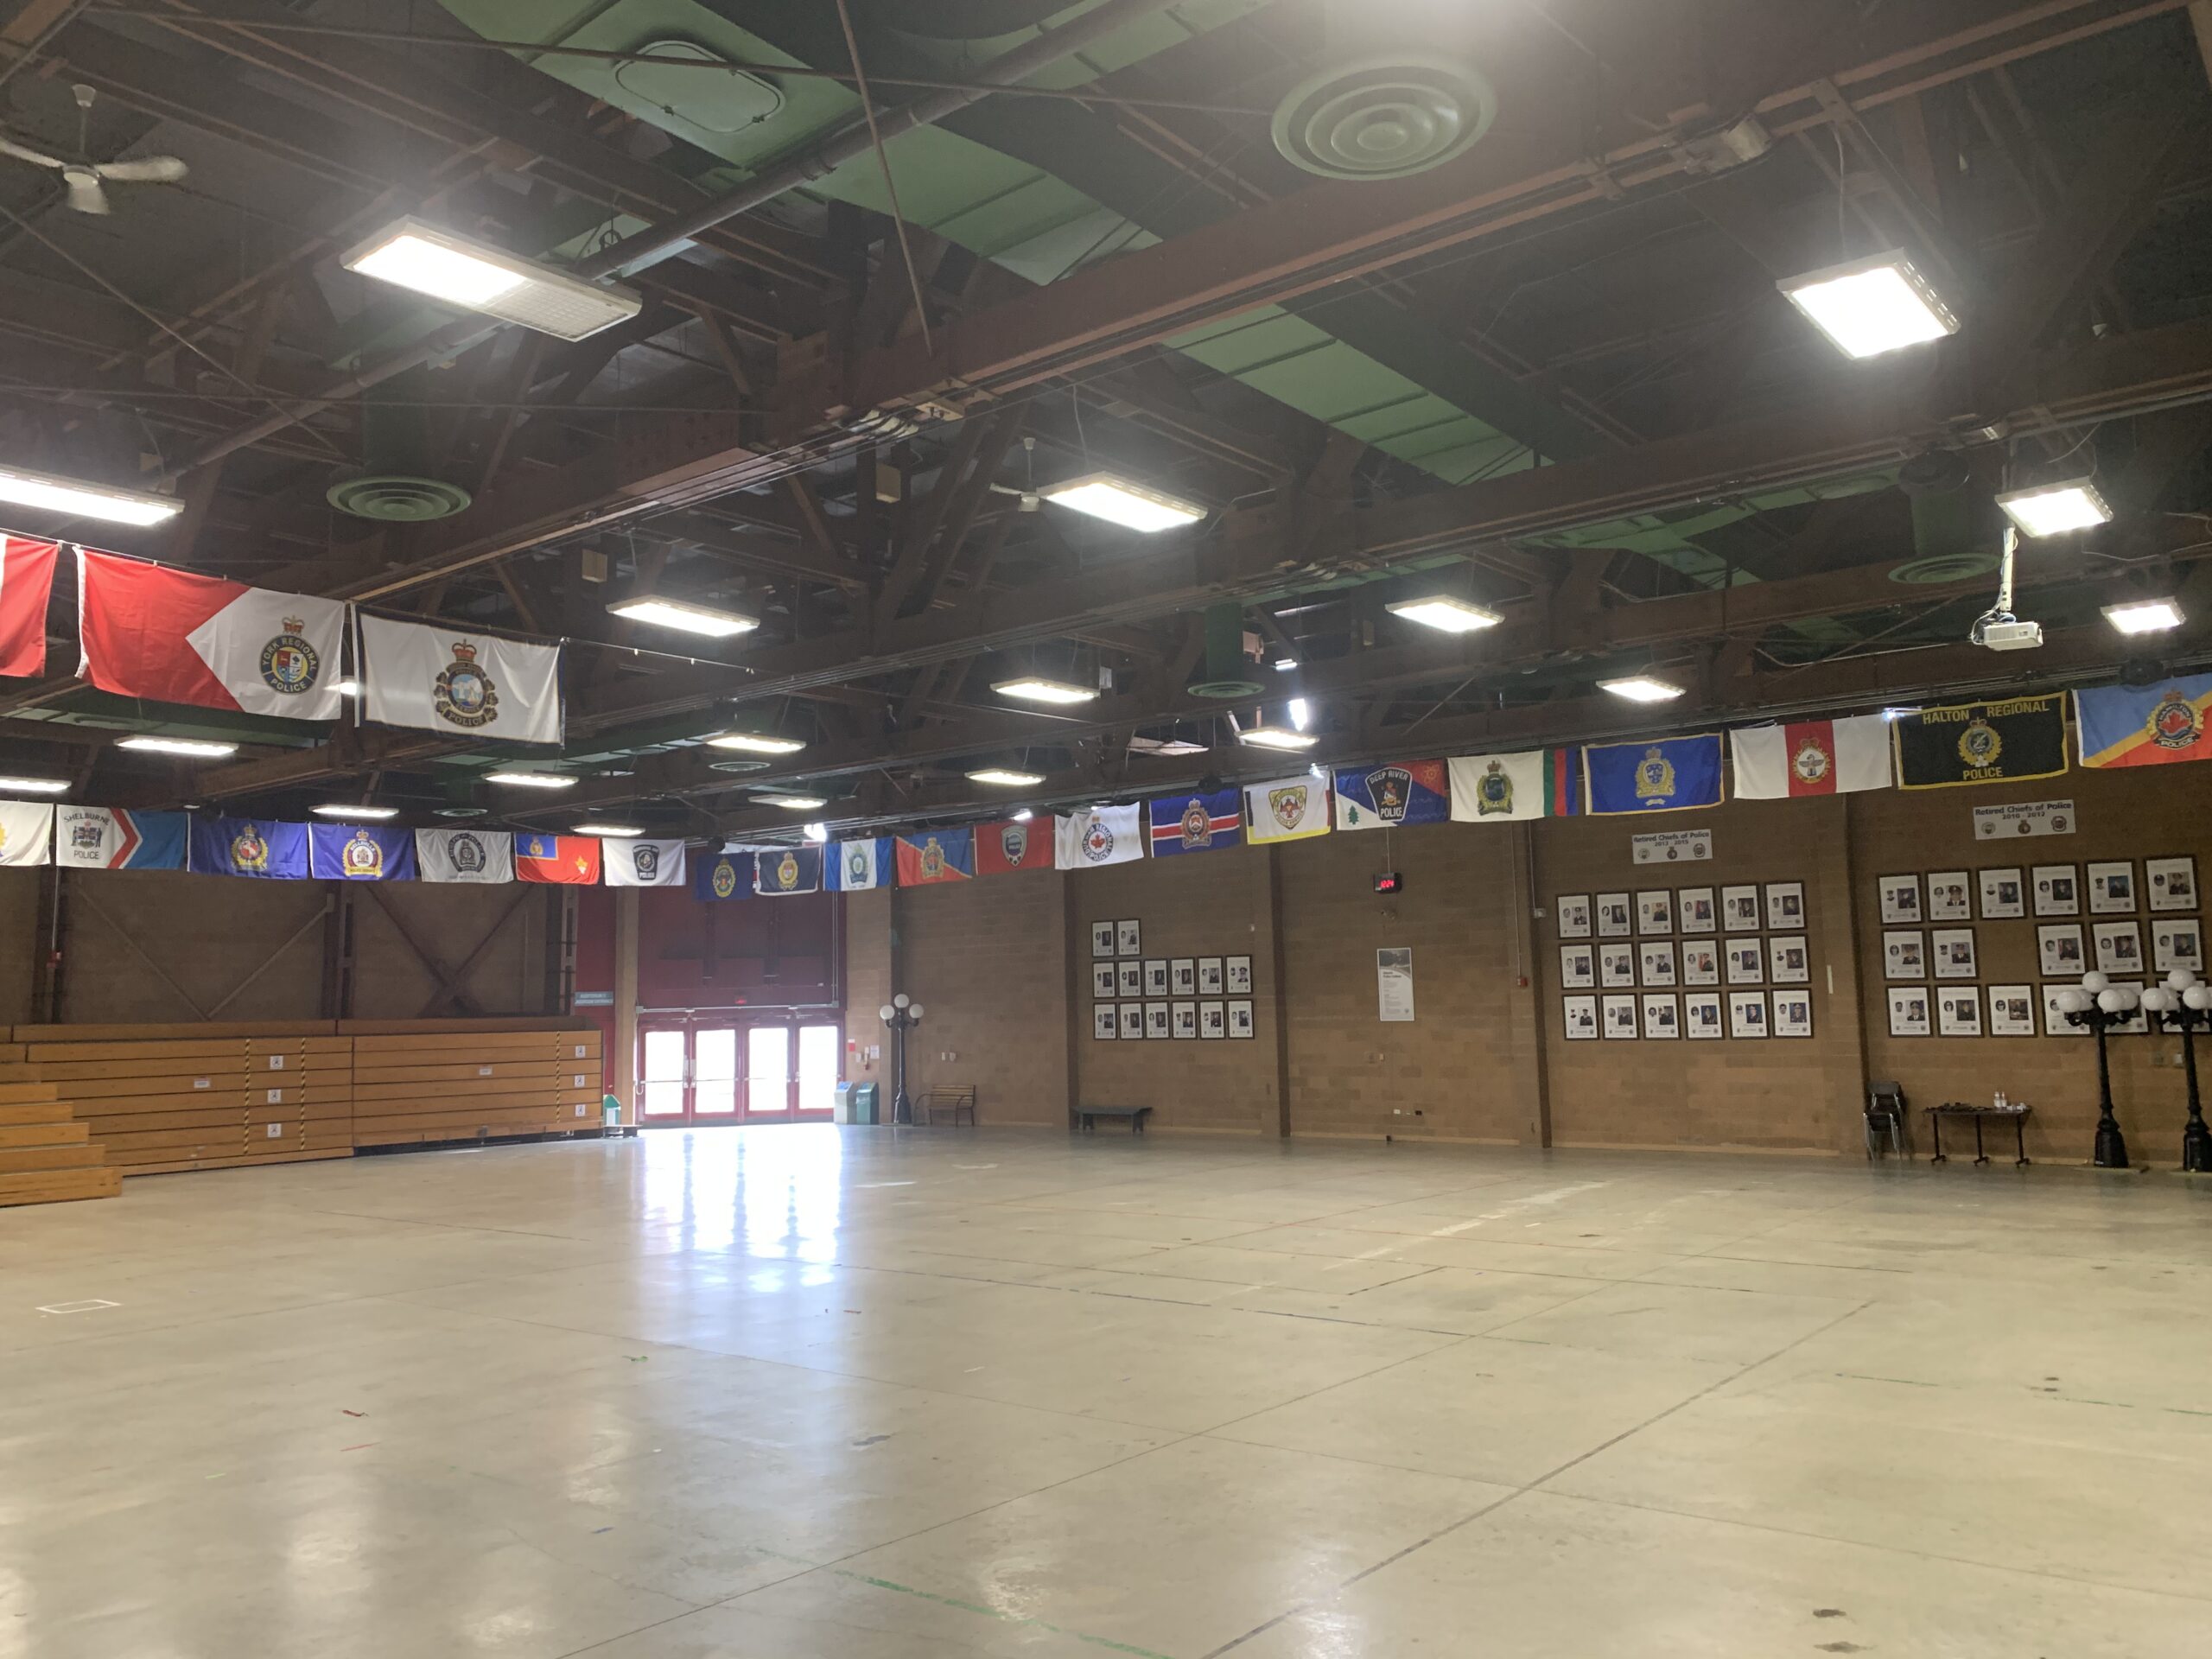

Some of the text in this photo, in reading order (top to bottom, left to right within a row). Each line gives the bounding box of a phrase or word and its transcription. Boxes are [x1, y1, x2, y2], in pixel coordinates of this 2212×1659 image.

[262, 638, 317, 671] YORK REGIONAL
[270, 678, 307, 691] POLICE
[1923, 701, 2050, 724] HALTON REGIONAL
[2158, 703, 2192, 720] HAMILTON
[448, 713, 484, 726] POLICE
[2160, 736, 2194, 747] POLICE
[1370, 770, 1408, 785] DEEP RIVER
[1963, 766, 2003, 780] POLICE
[1380, 807, 1402, 818] POLICE
[1975, 806, 2005, 816] Retired
[2006, 804, 2032, 813] Chiefs
[64, 812, 110, 826] SHELBURNE
[73, 849, 99, 860] POLICE
[1090, 850, 1109, 861] POLICE
